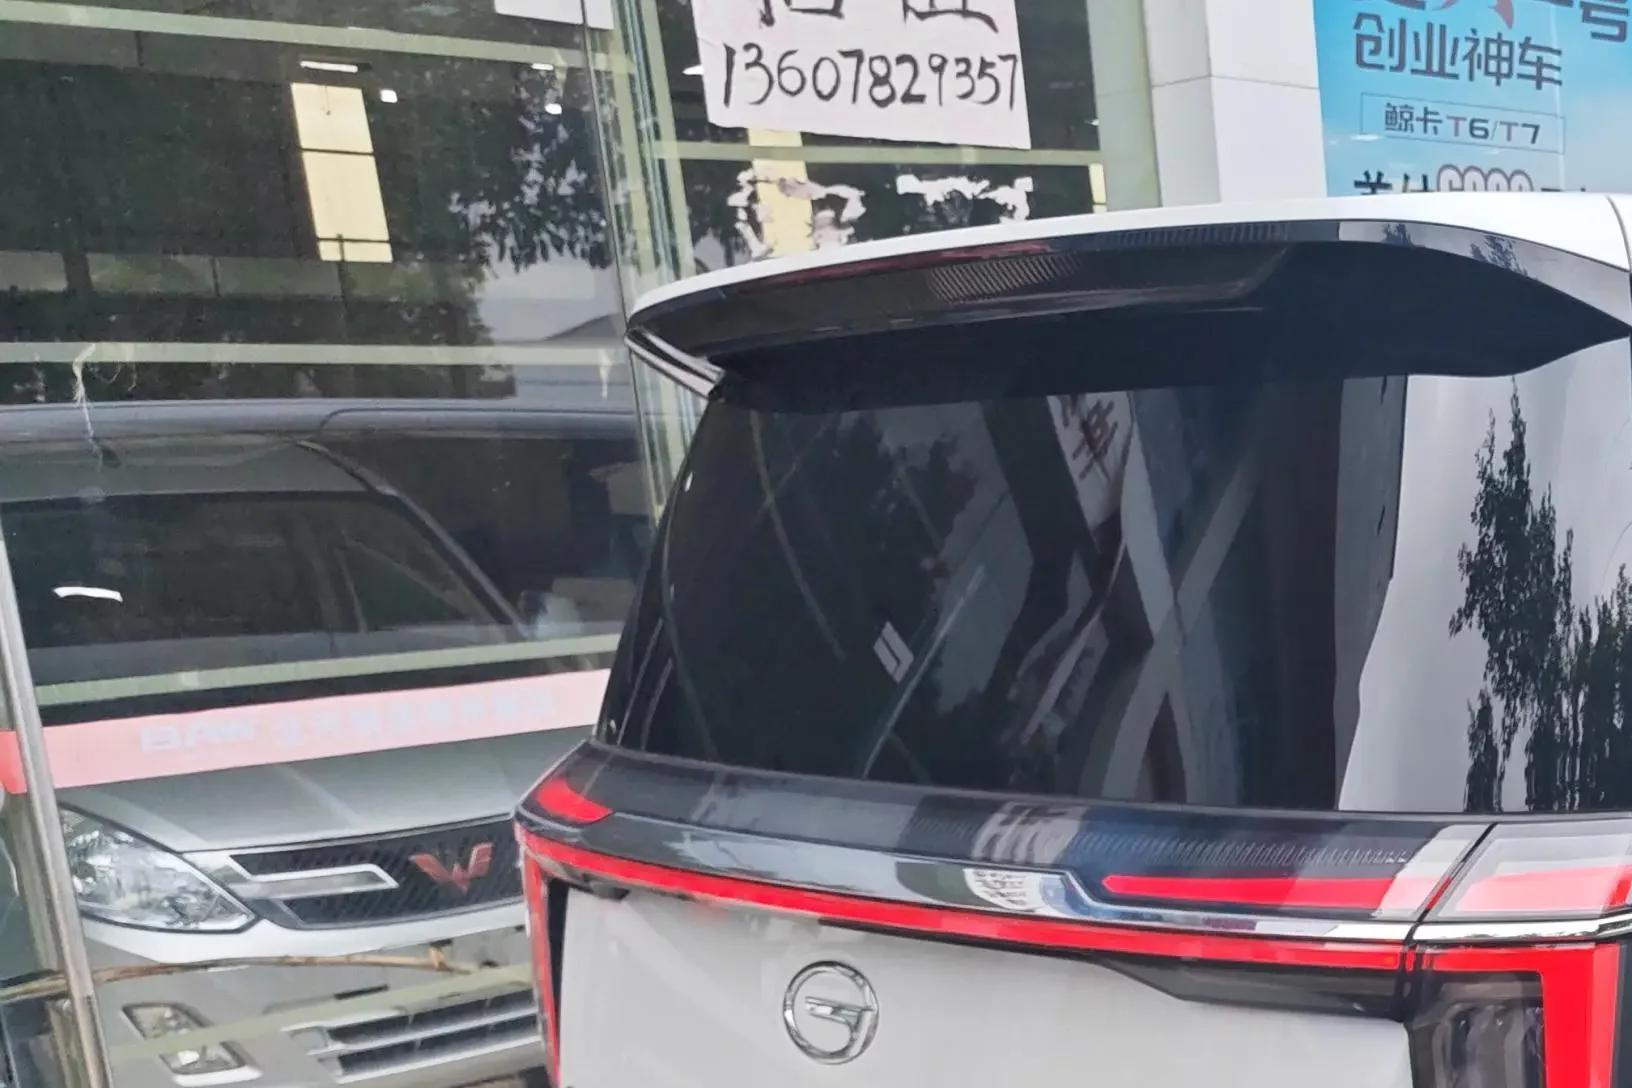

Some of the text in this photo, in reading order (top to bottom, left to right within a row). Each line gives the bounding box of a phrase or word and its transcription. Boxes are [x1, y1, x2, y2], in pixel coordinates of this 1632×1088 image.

[723, 42, 1018, 111] 13607829357
[1353, 12, 1563, 90] 创业神车
